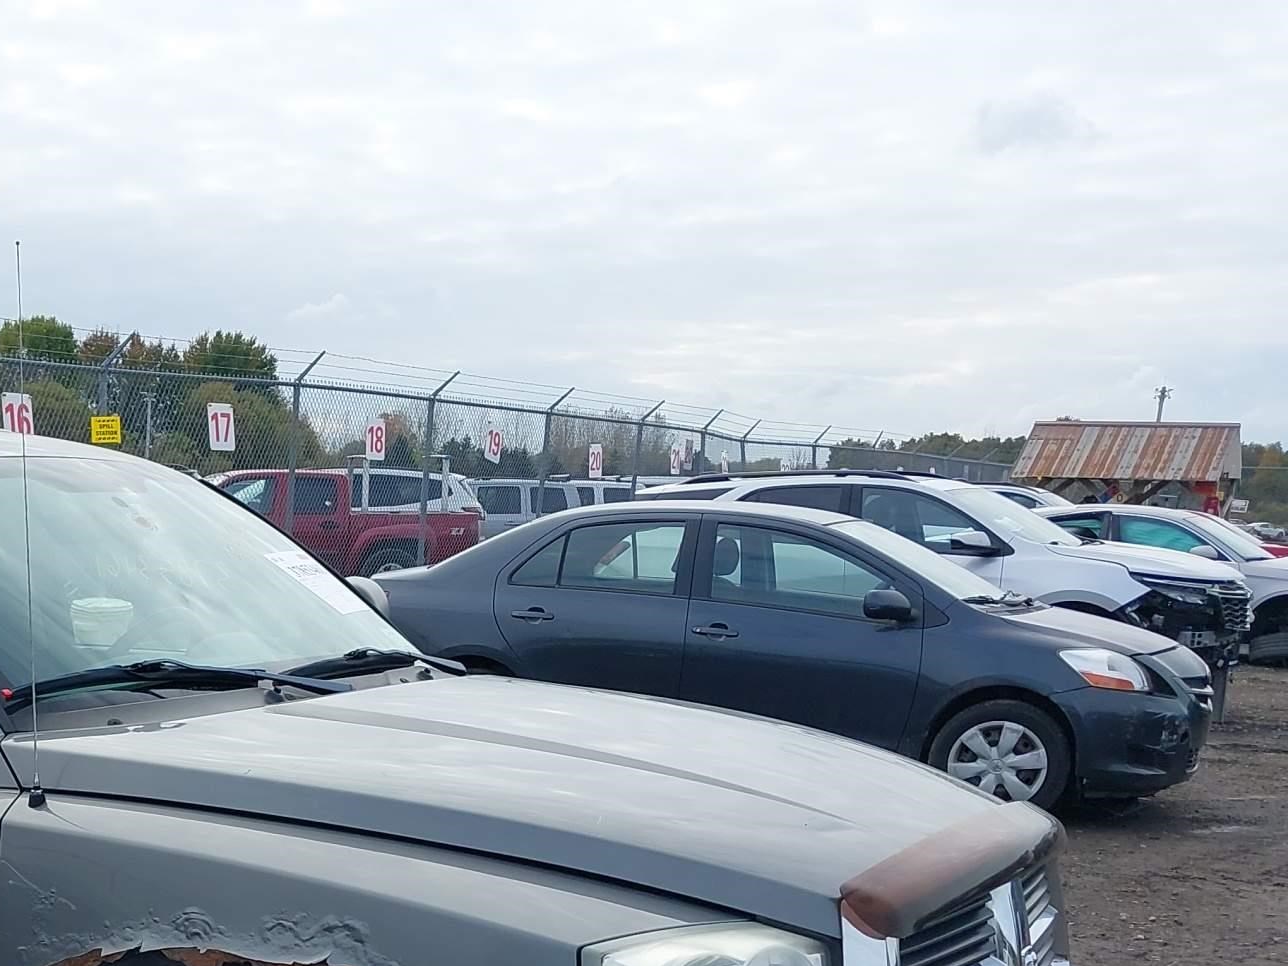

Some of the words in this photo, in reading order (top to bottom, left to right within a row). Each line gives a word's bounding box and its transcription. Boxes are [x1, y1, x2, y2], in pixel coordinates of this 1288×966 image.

[5, 403, 31, 434] 16
[211, 412, 231, 442] 17
[368, 426, 383, 453] 18
[488, 430, 501, 456] 19
[590, 451, 601, 470] 20
